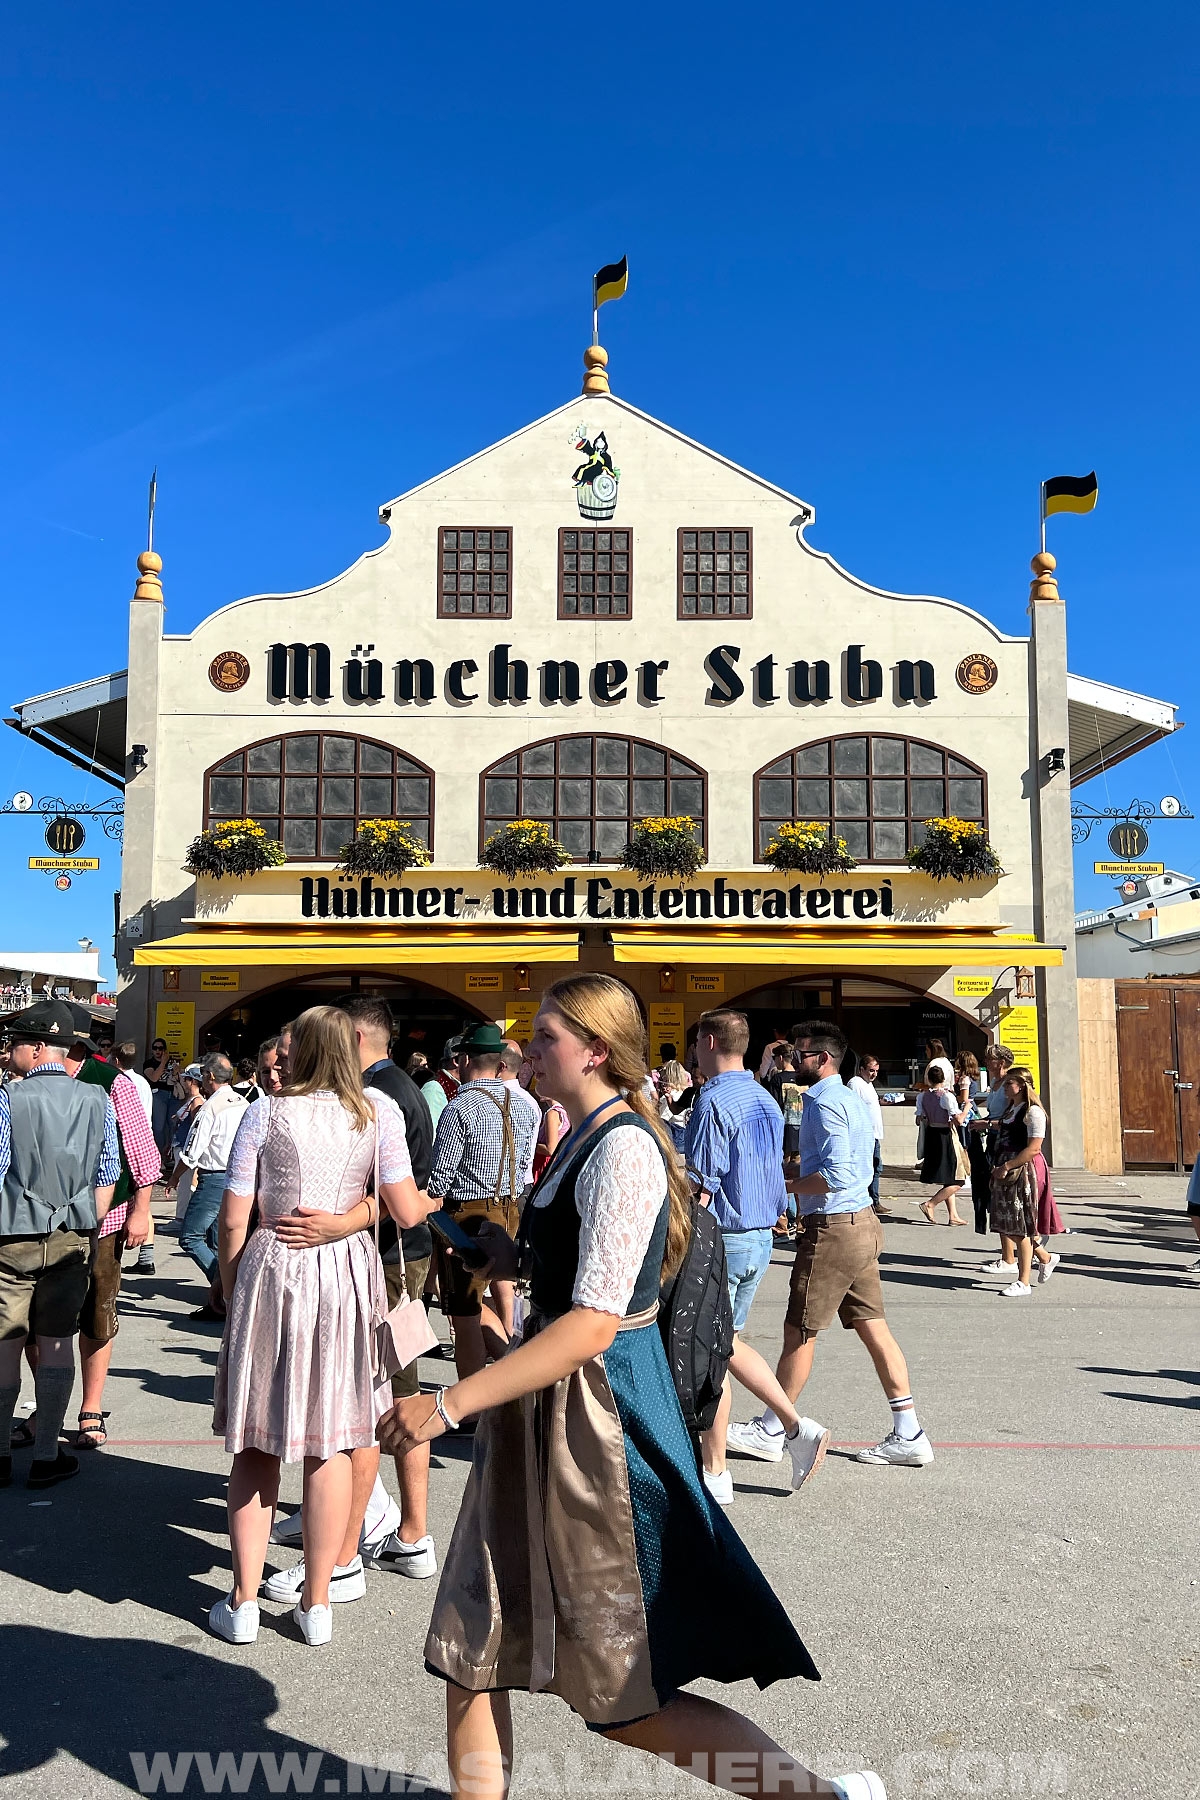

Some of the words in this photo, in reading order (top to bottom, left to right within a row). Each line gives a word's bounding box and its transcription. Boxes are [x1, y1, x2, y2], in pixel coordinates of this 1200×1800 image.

[960, 654, 996, 669] PAULANER
[268, 642, 669, 702] Münchner
[708, 643, 938, 702] Stubn
[35, 859, 71, 867] Münchner
[1100, 864, 1136, 872] Münchner
[299, 876, 481, 918] Hühner-
[492, 876, 578, 918] und
[586, 877, 895, 919] Entenbraterei
[130, 925, 140, 933] 26
